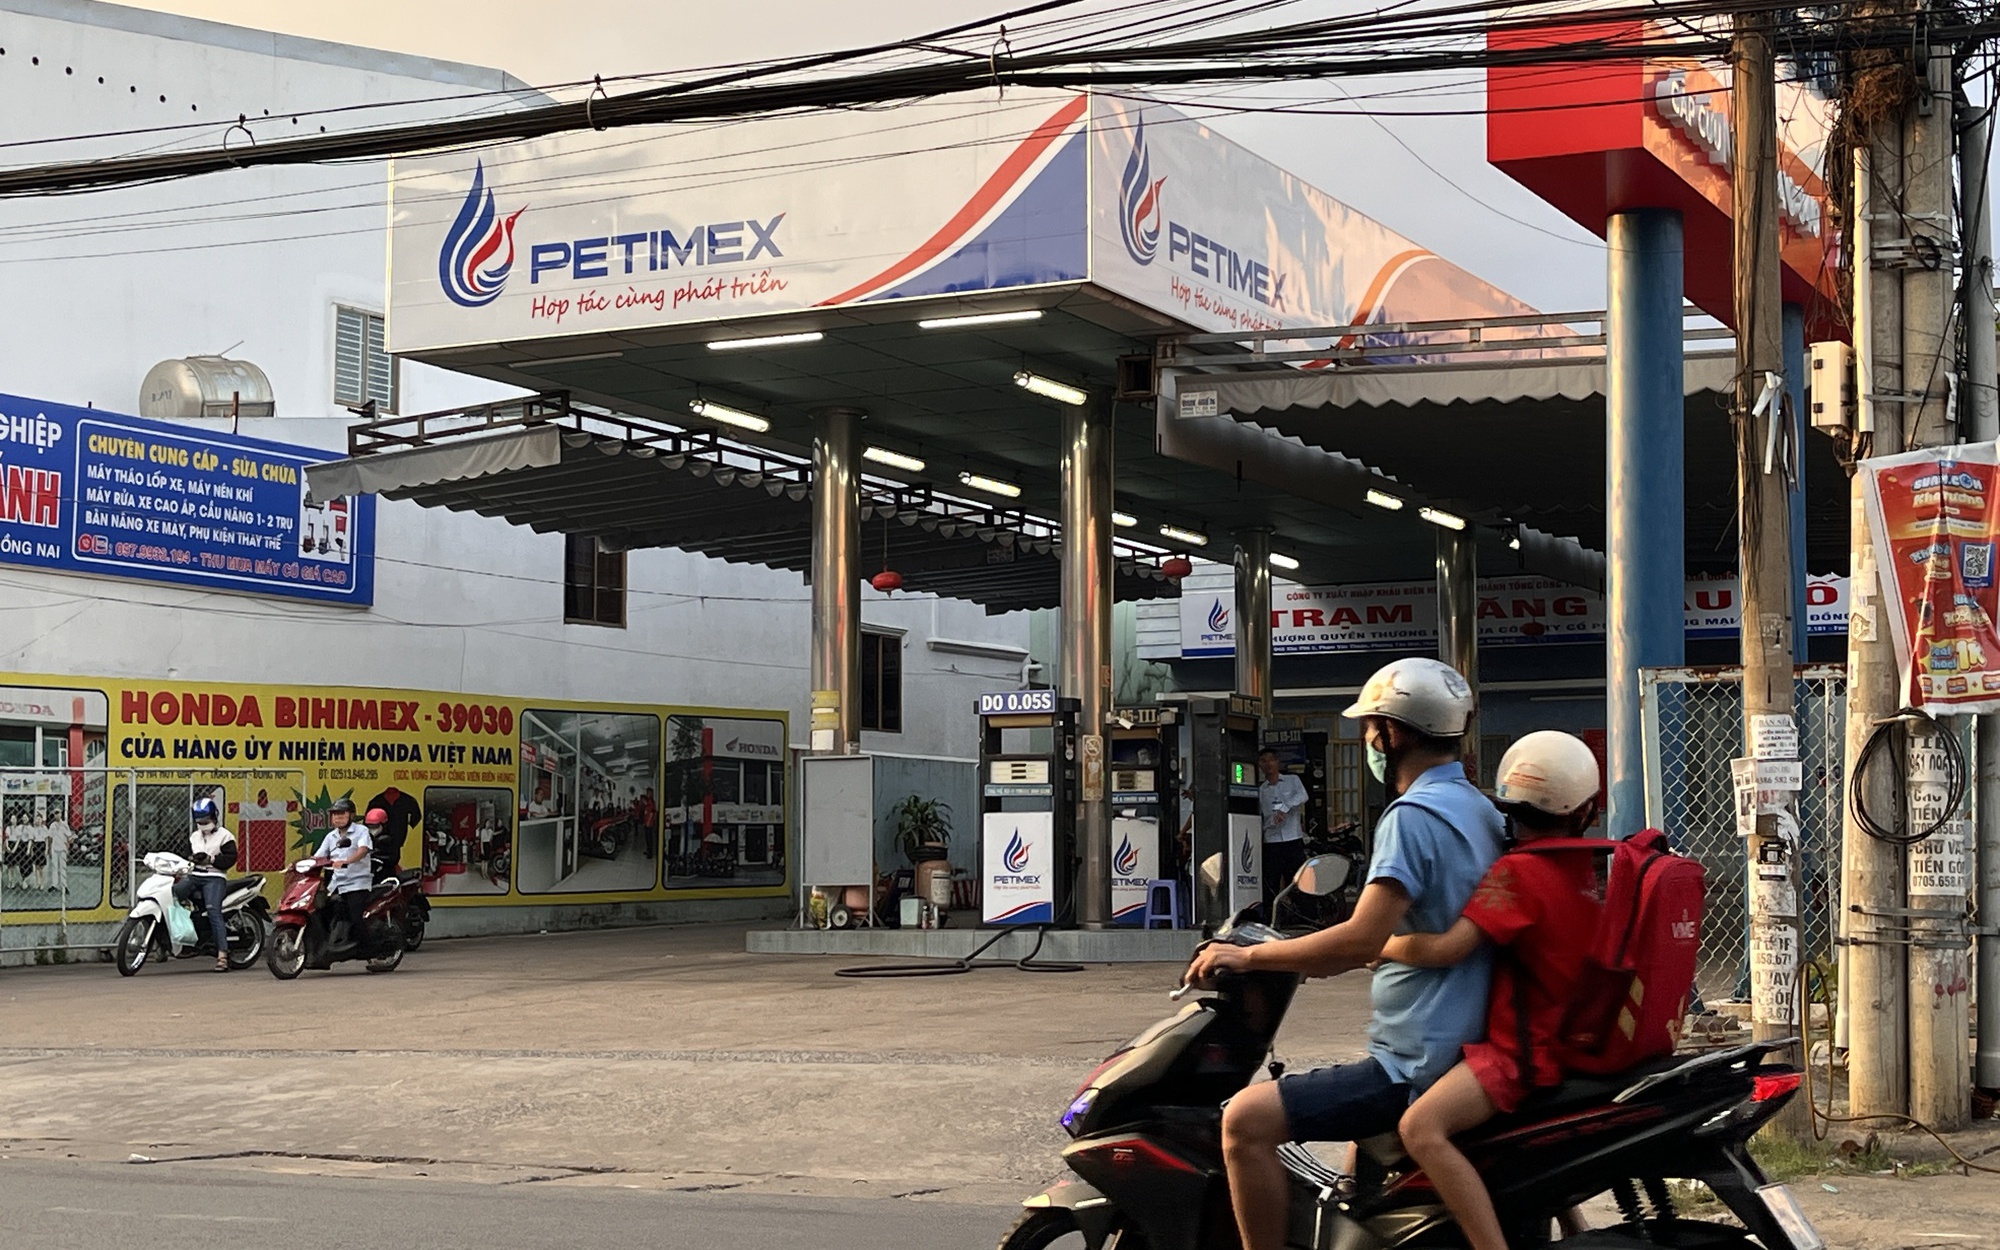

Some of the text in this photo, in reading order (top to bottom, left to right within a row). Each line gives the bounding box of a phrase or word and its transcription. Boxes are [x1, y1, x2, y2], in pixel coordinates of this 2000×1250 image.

[531, 212, 785, 284] PETIMEX
[1169, 220, 1287, 314] PETIMEX
[531, 267, 788, 324] Hợp tác cùng phát triển
[1194, 287, 1212, 311] tác
[1212, 296, 1237, 329] cùng
[88, 434, 145, 460] CHUYÊN
[149, 444, 189, 467] CUNG
[192, 447, 219, 472] CẤP
[232, 456, 258, 479] SỬA
[262, 463, 297, 485] CHỮA
[87, 463, 112, 481] MÁY
[146, 470, 167, 489] LỐP
[169, 477, 185, 494] XE,
[188, 479, 211, 496] MÁY
[236, 487, 253, 503] KHÍ
[86, 486, 111, 503] MÁY
[113, 488, 135, 508] RỬA
[138, 495, 151, 509] XE
[154, 498, 178, 513] CAO
[224, 507, 254, 525] NÂNG
[276, 516, 294, 534] TRỤ
[111, 512, 143, 531] NÂNG
[146, 519, 159, 534] XE
[189, 525, 210, 544] PHỤ
[213, 526, 234, 546] KIỆN
[237, 531, 262, 547] THAY
[36, 542, 60, 559] NAI
[200, 552, 224, 569] THU
[254, 559, 280, 577] MÁY
[322, 568, 347, 585] CAO
[1271, 578, 1841, 629] TRẠM ĂNG Ố
[1200, 633, 1236, 641] PETIME
[1272, 633, 1316, 642] HƯỢNG
[0, 702, 55, 716] ONDA
[121, 690, 264, 728] HONDA
[275, 696, 420, 732] BIHIMEX
[436, 703, 514, 736] 39030
[982, 692, 1051, 712] DO 0.05S
[120, 732, 513, 768] CỬA HÀNG ỦY NHIỆM HONDA VIỆT NAM
[738, 742, 778, 756] HONDA
[1948, 841, 1964, 855] VA
[993, 874, 1042, 884] PETIMEX
[1111, 877, 1148, 886] ETIMEX
